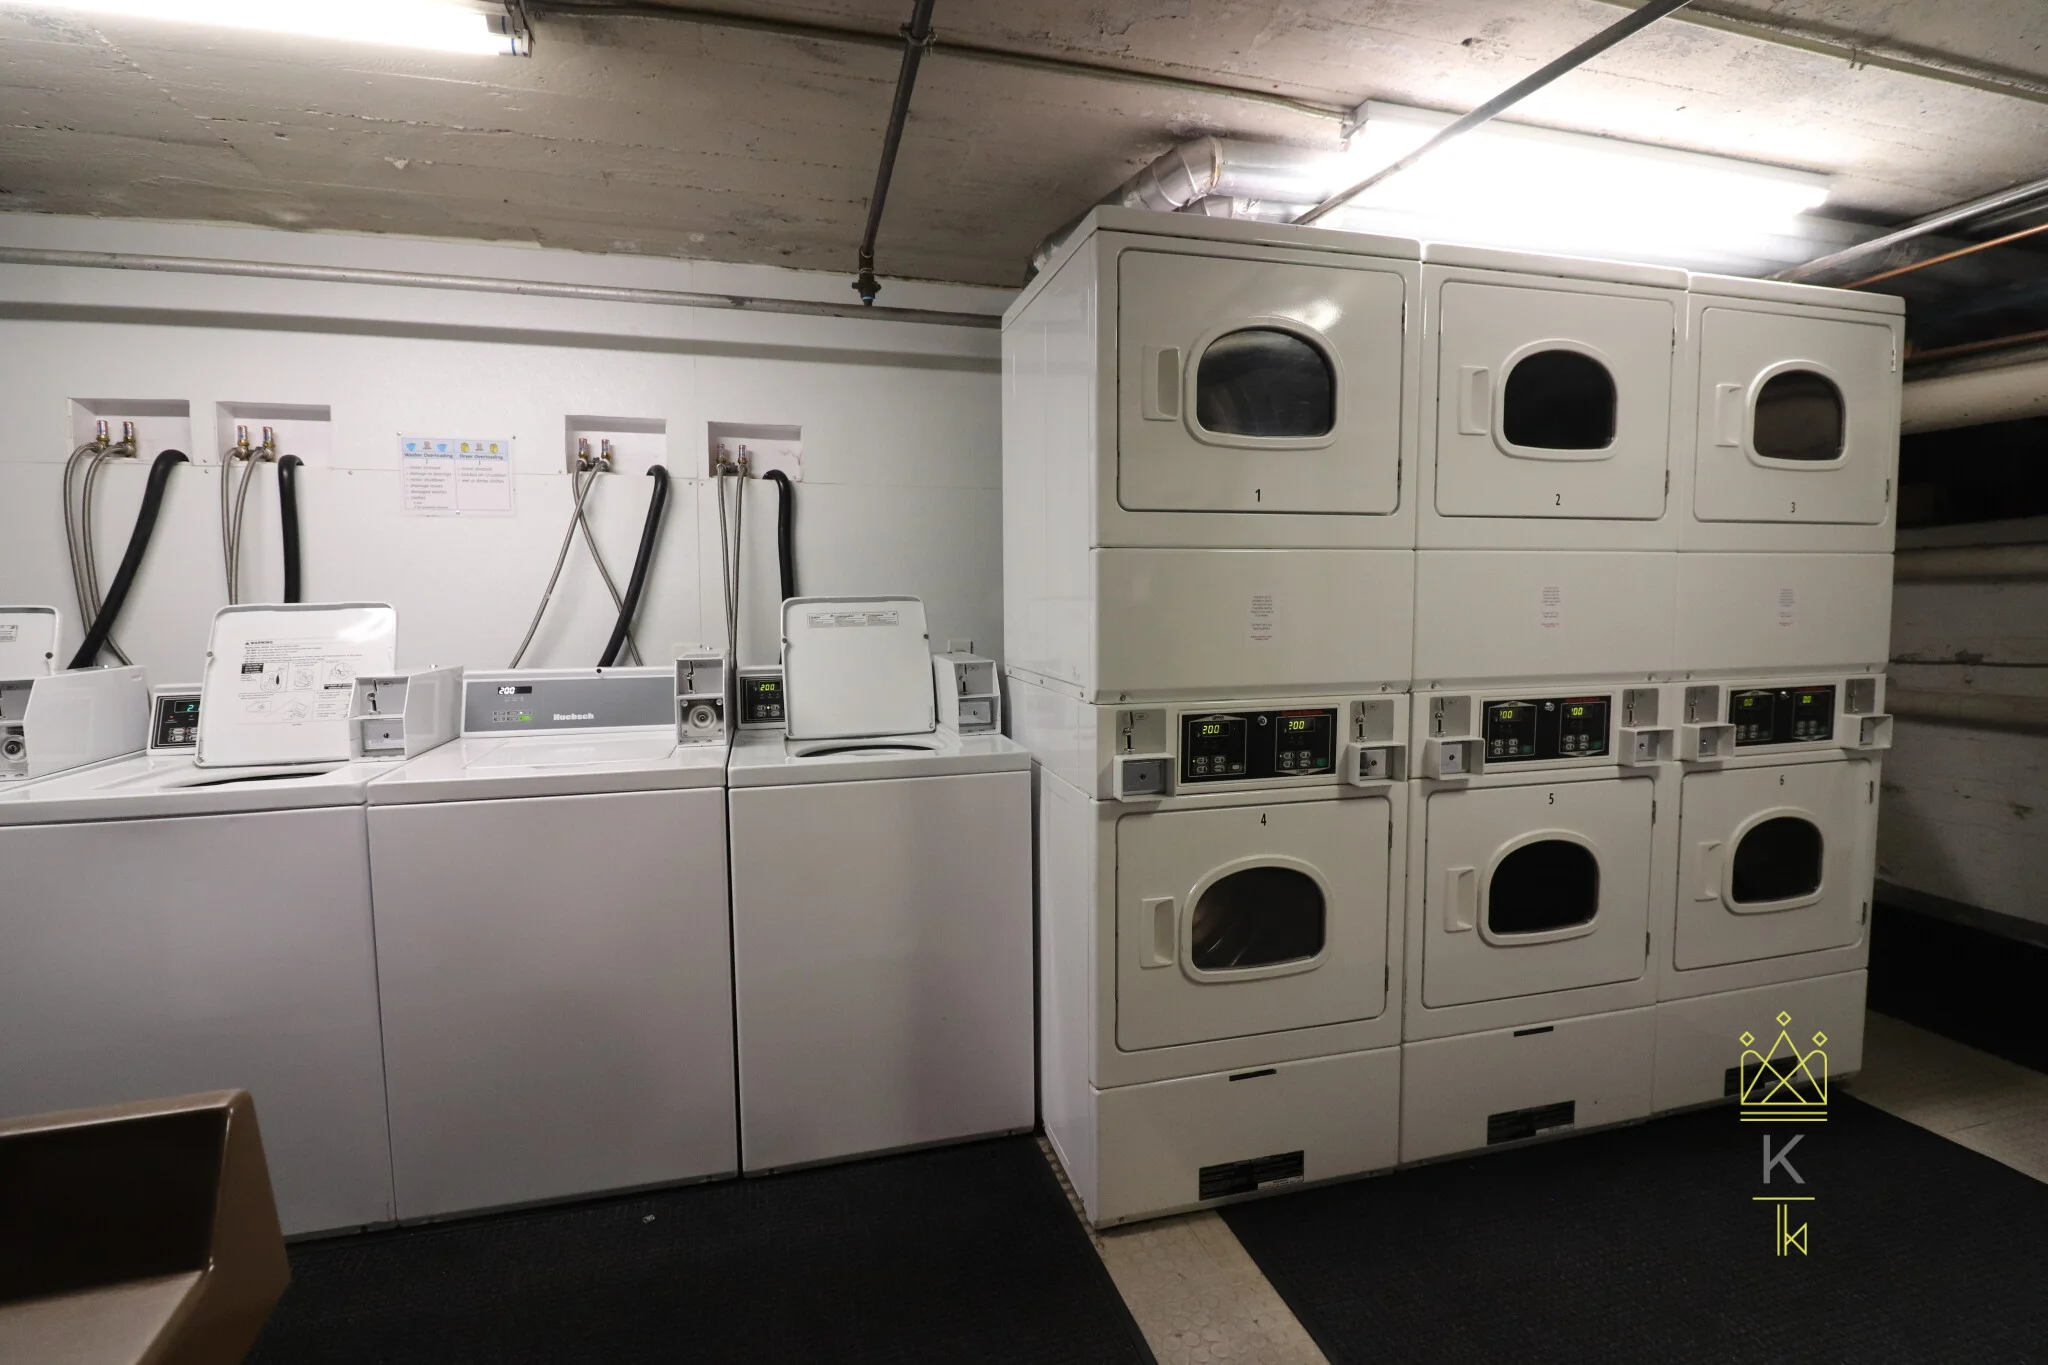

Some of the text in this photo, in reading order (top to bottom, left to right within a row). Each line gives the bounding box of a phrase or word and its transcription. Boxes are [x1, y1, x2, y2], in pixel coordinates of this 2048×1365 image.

[1255, 488, 1261, 503] 1
[1555, 493, 1561, 506] 2
[1791, 501, 1796, 513] 3
[498, 686, 516, 695] 200
[553, 712, 595, 721] Huebsch
[1202, 724, 1220, 734] 200
[1779, 774, 1785, 786] 6
[1549, 792, 1554, 805] 5
[1260, 813, 1267, 827] 4
